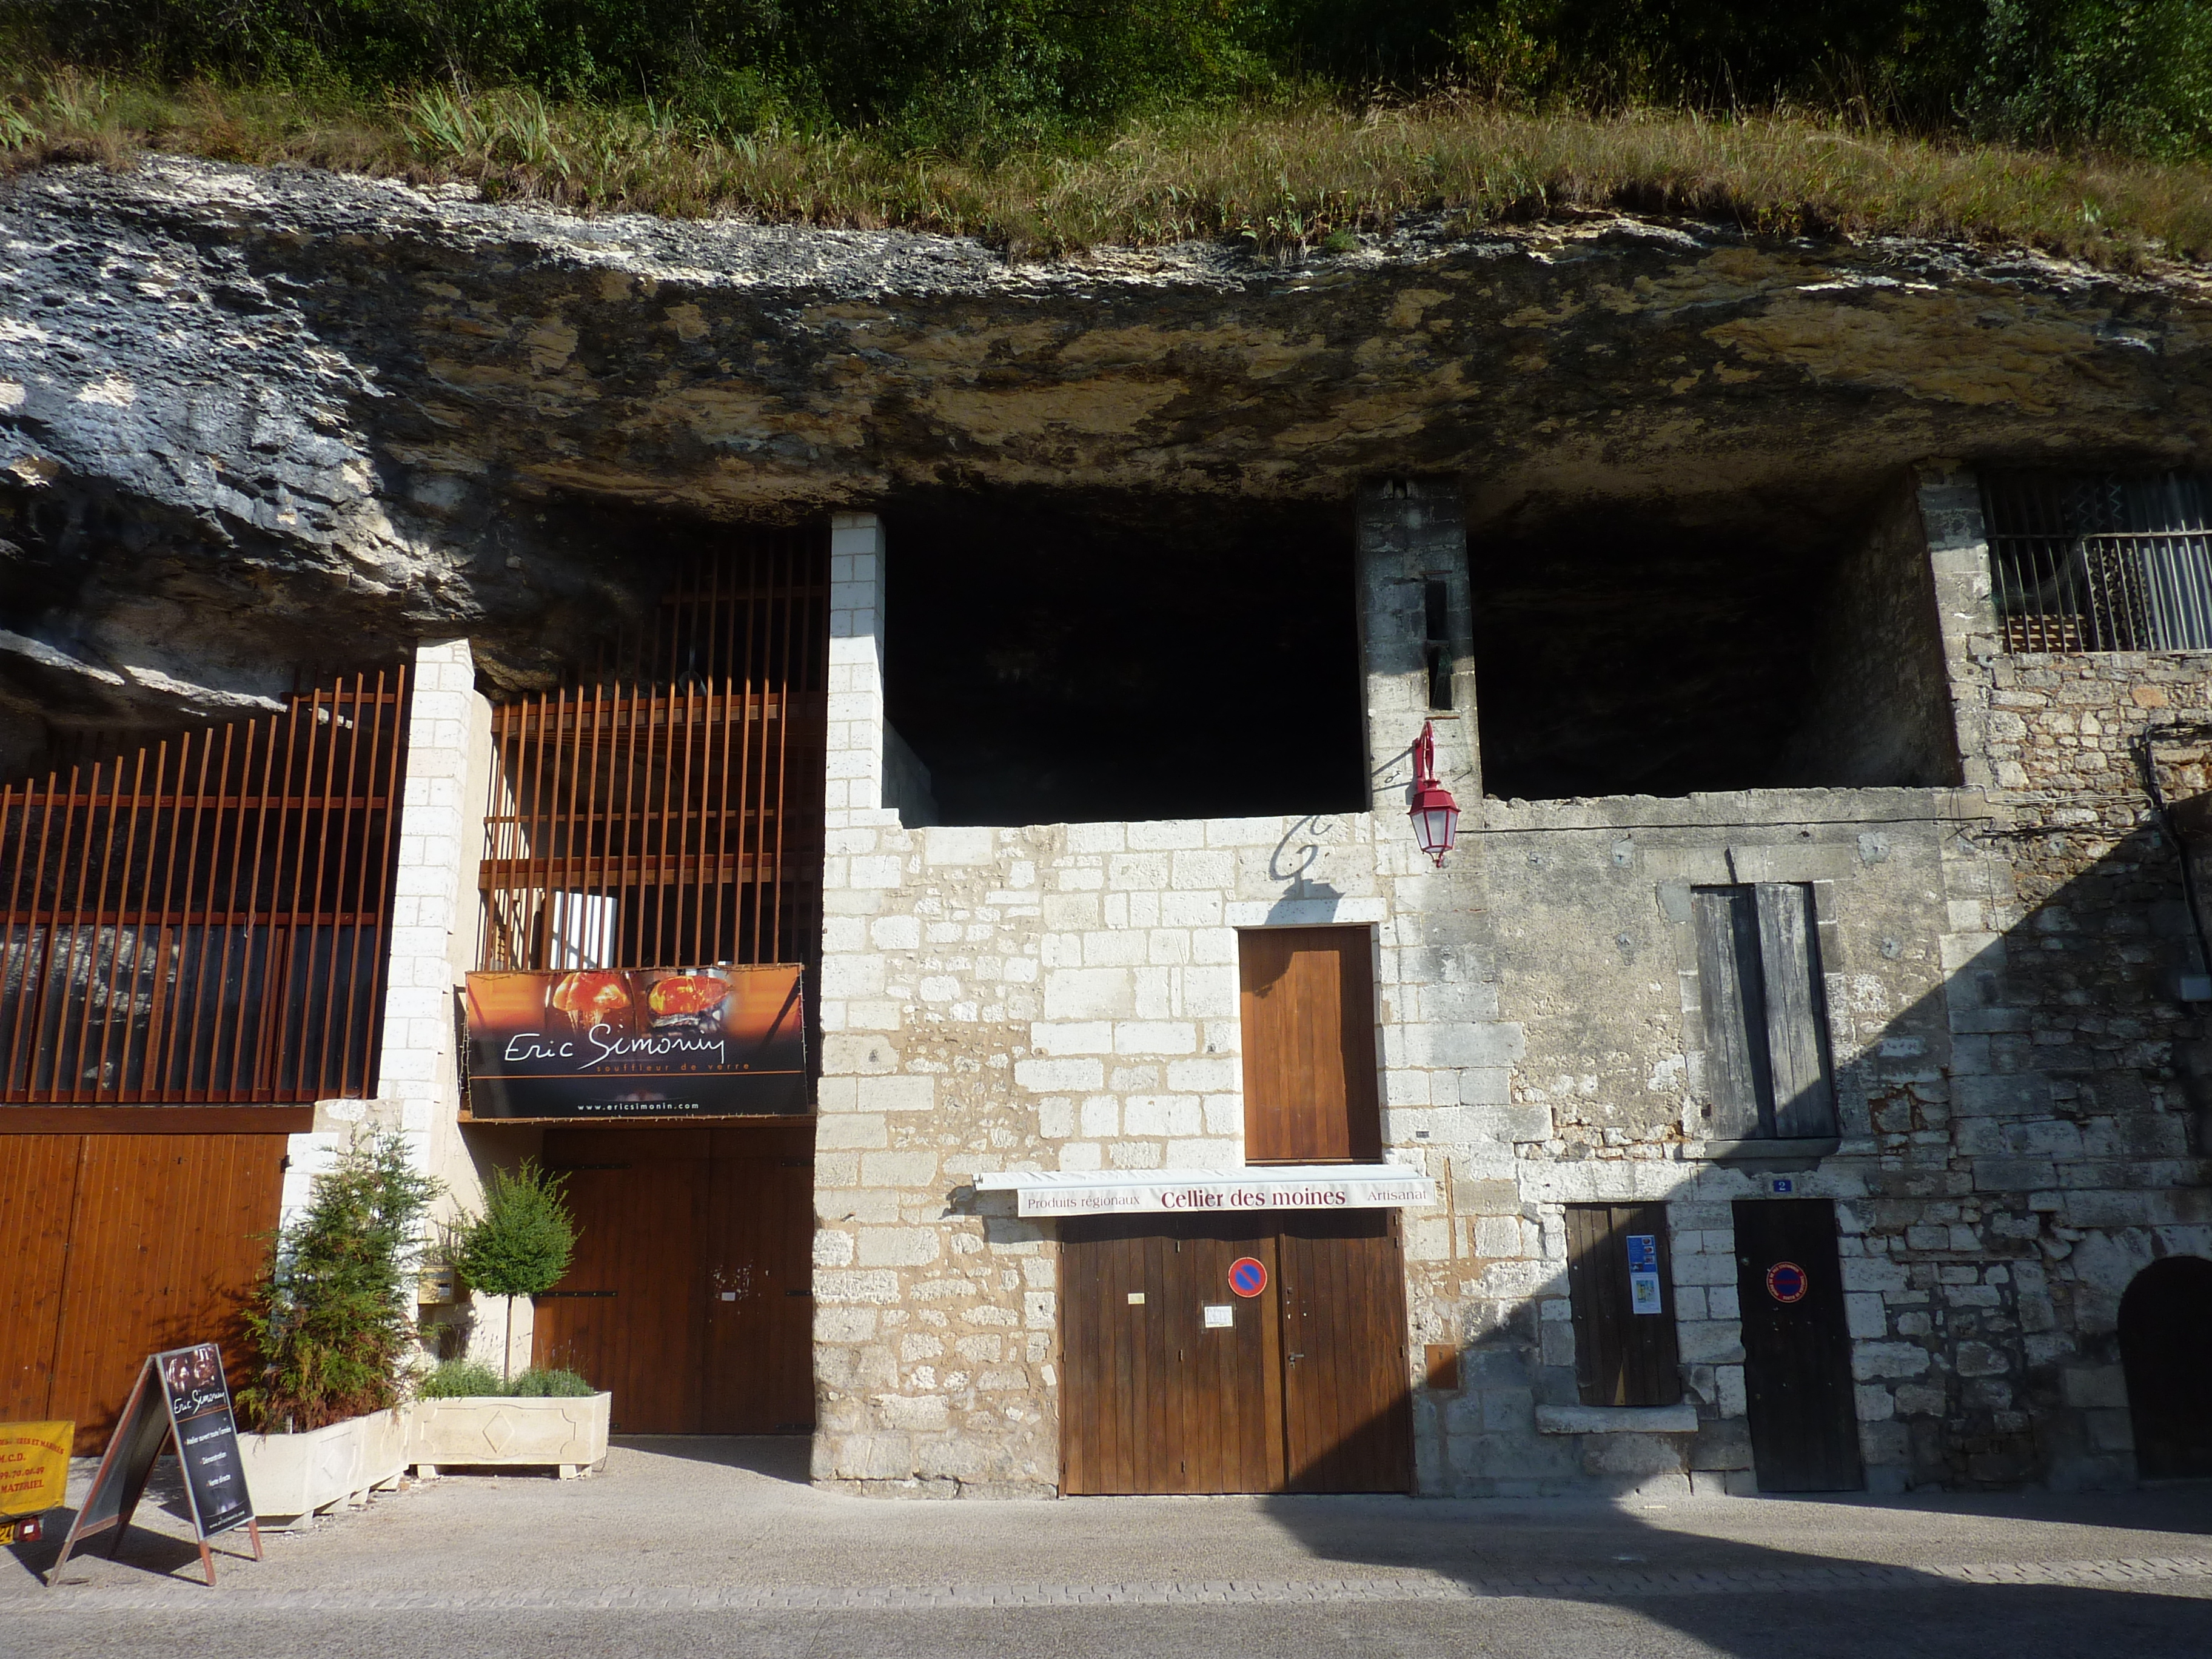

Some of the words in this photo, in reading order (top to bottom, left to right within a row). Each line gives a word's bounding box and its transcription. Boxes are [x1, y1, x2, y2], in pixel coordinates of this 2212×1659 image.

[504, 1033, 574, 1061] Eric
[577, 1024, 725, 1070] Simonin
[596, 1063, 669, 1073] souffleur
[680, 1062, 697, 1071] de
[708, 1062, 750, 1071] verre
[577, 1102, 699, 1111] www.ericsimonin.com
[1778, 1181, 1786, 1191] 2
[1161, 1188, 1224, 1208] Cellier
[1230, 1189, 1265, 1207] des
[1272, 1187, 1346, 1206] moines
[1367, 1190, 1427, 1201] Artisanat
[1027, 1197, 1077, 1209] Produits
[1081, 1195, 1141, 1209] régionaux
[174, 1398, 192, 1414] Eric
